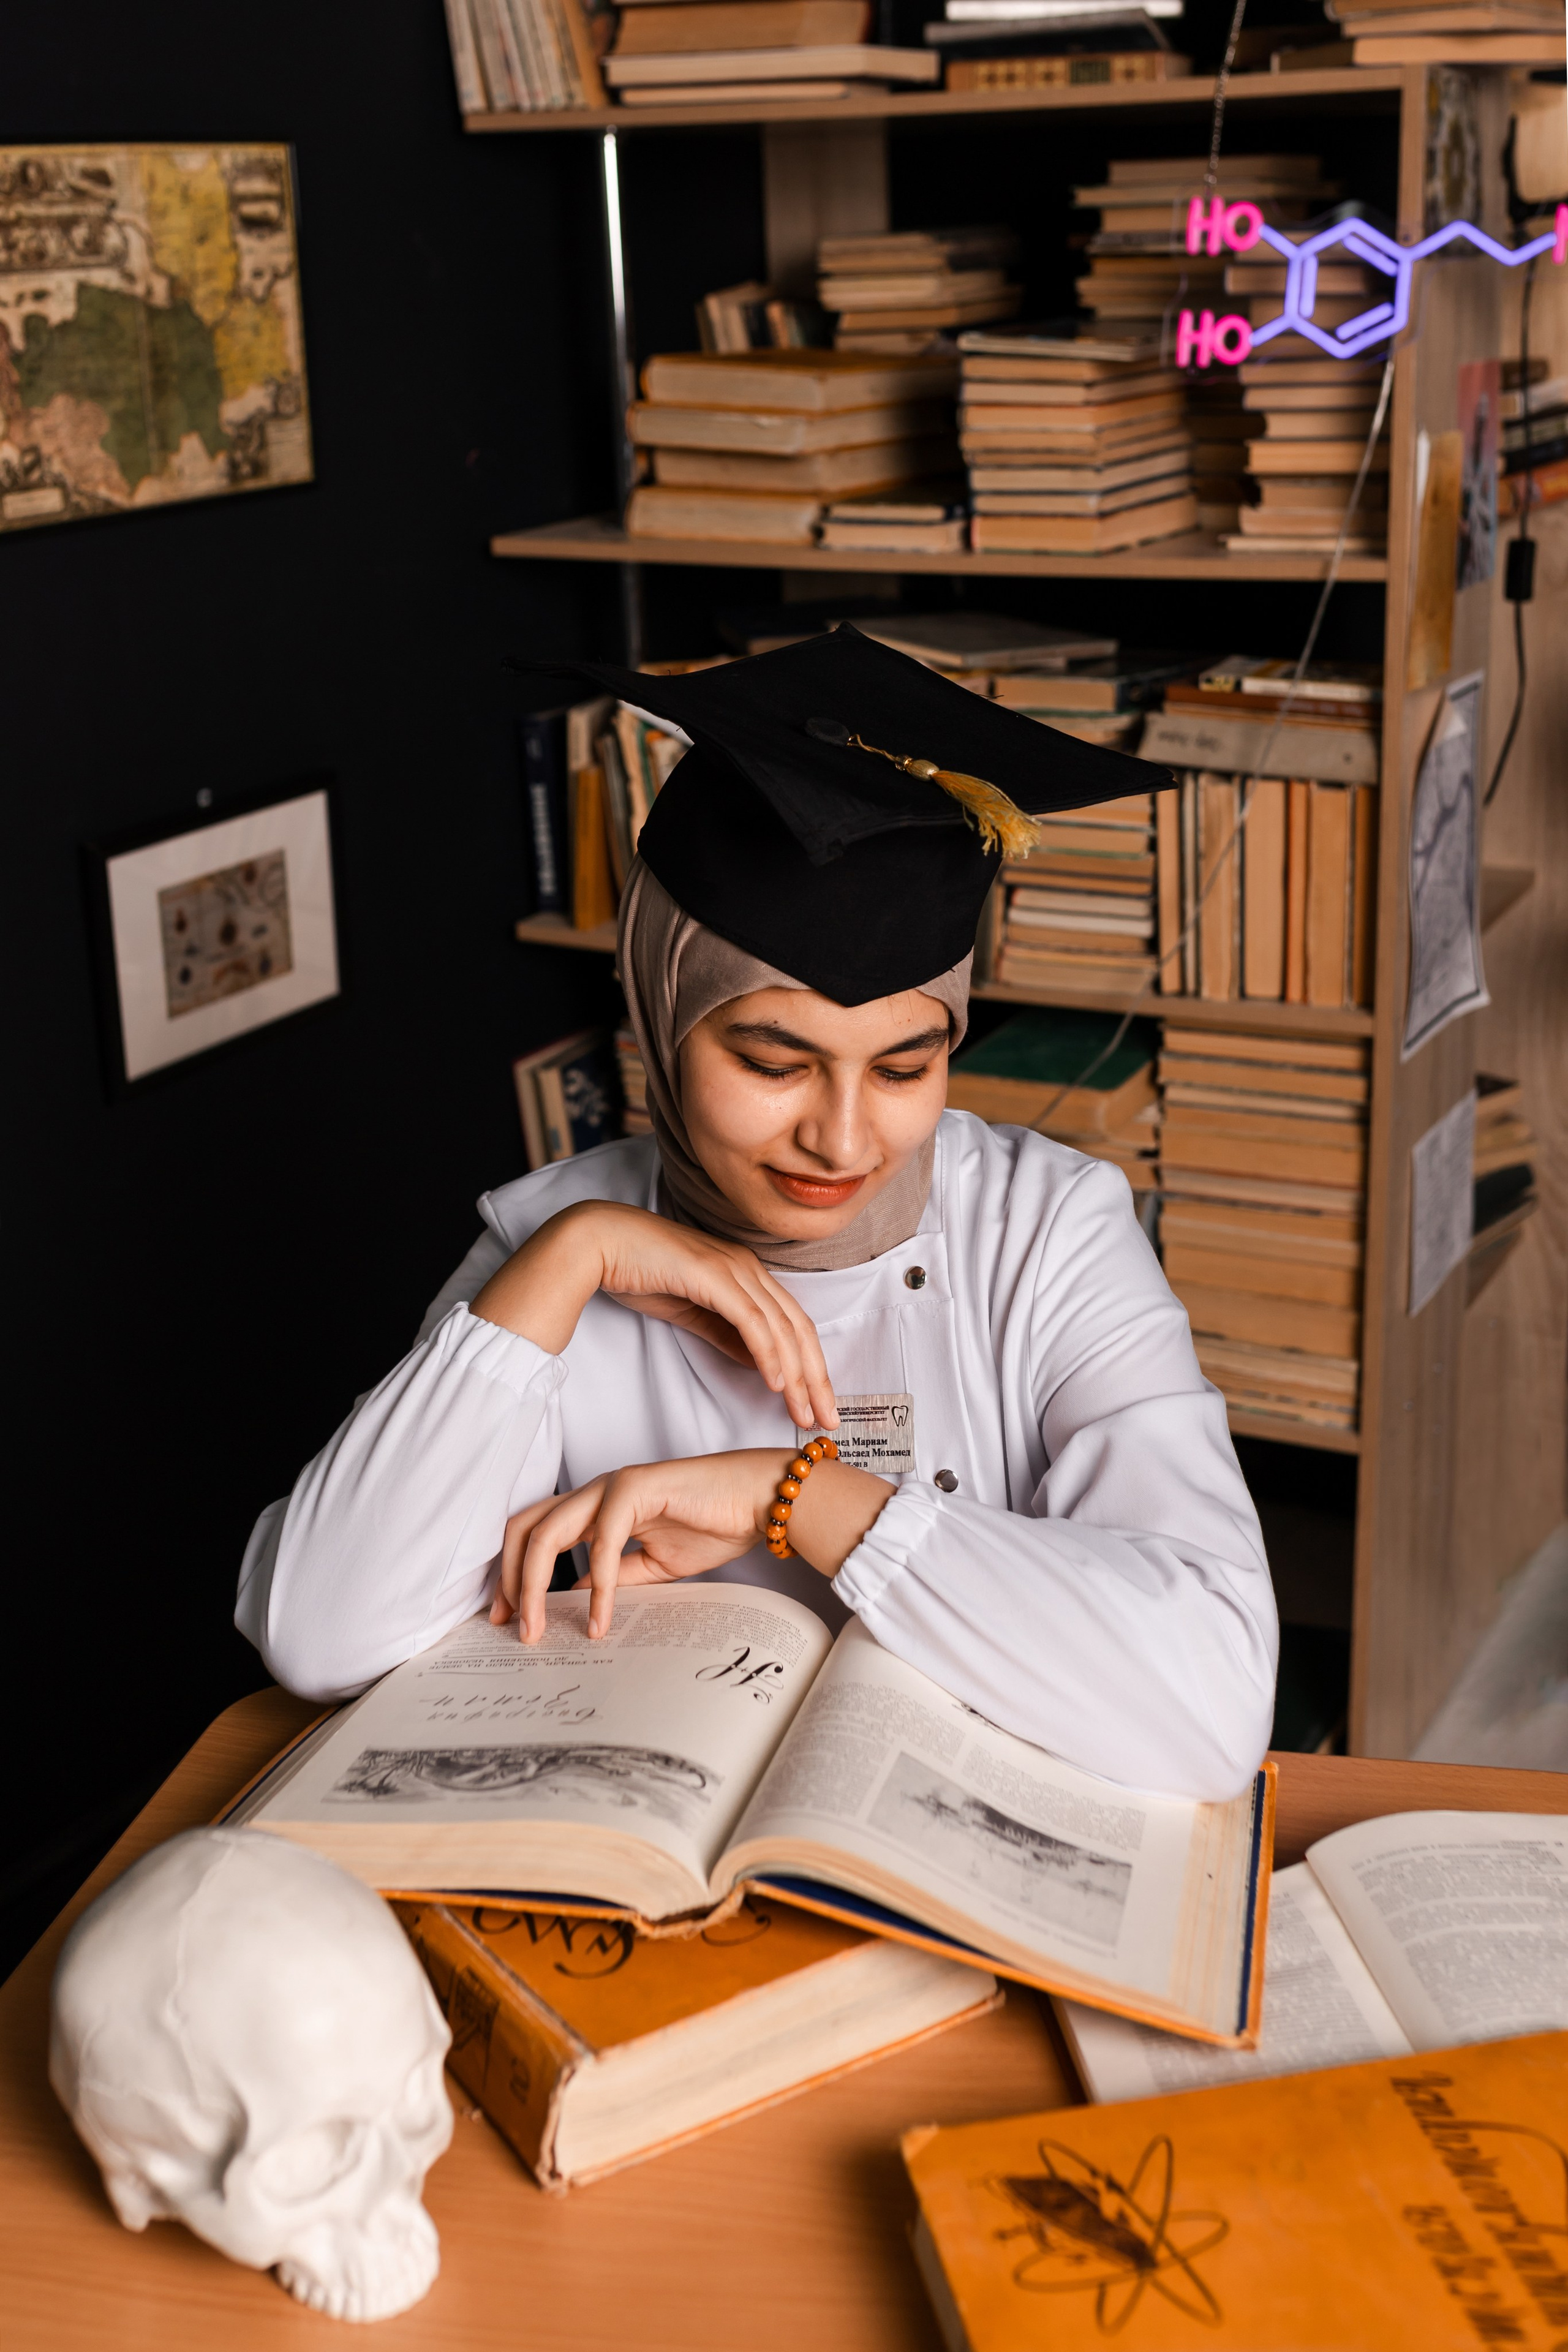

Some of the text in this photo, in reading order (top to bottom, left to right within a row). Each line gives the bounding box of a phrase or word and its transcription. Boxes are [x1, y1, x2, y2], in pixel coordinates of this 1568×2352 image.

[1186, 196, 1264, 256] HO
[1176, 309, 1253, 368] HO
[837, 1448, 911, 1458] Эльсаед Мохамед
[852, 1438, 888, 1447] Мариам
